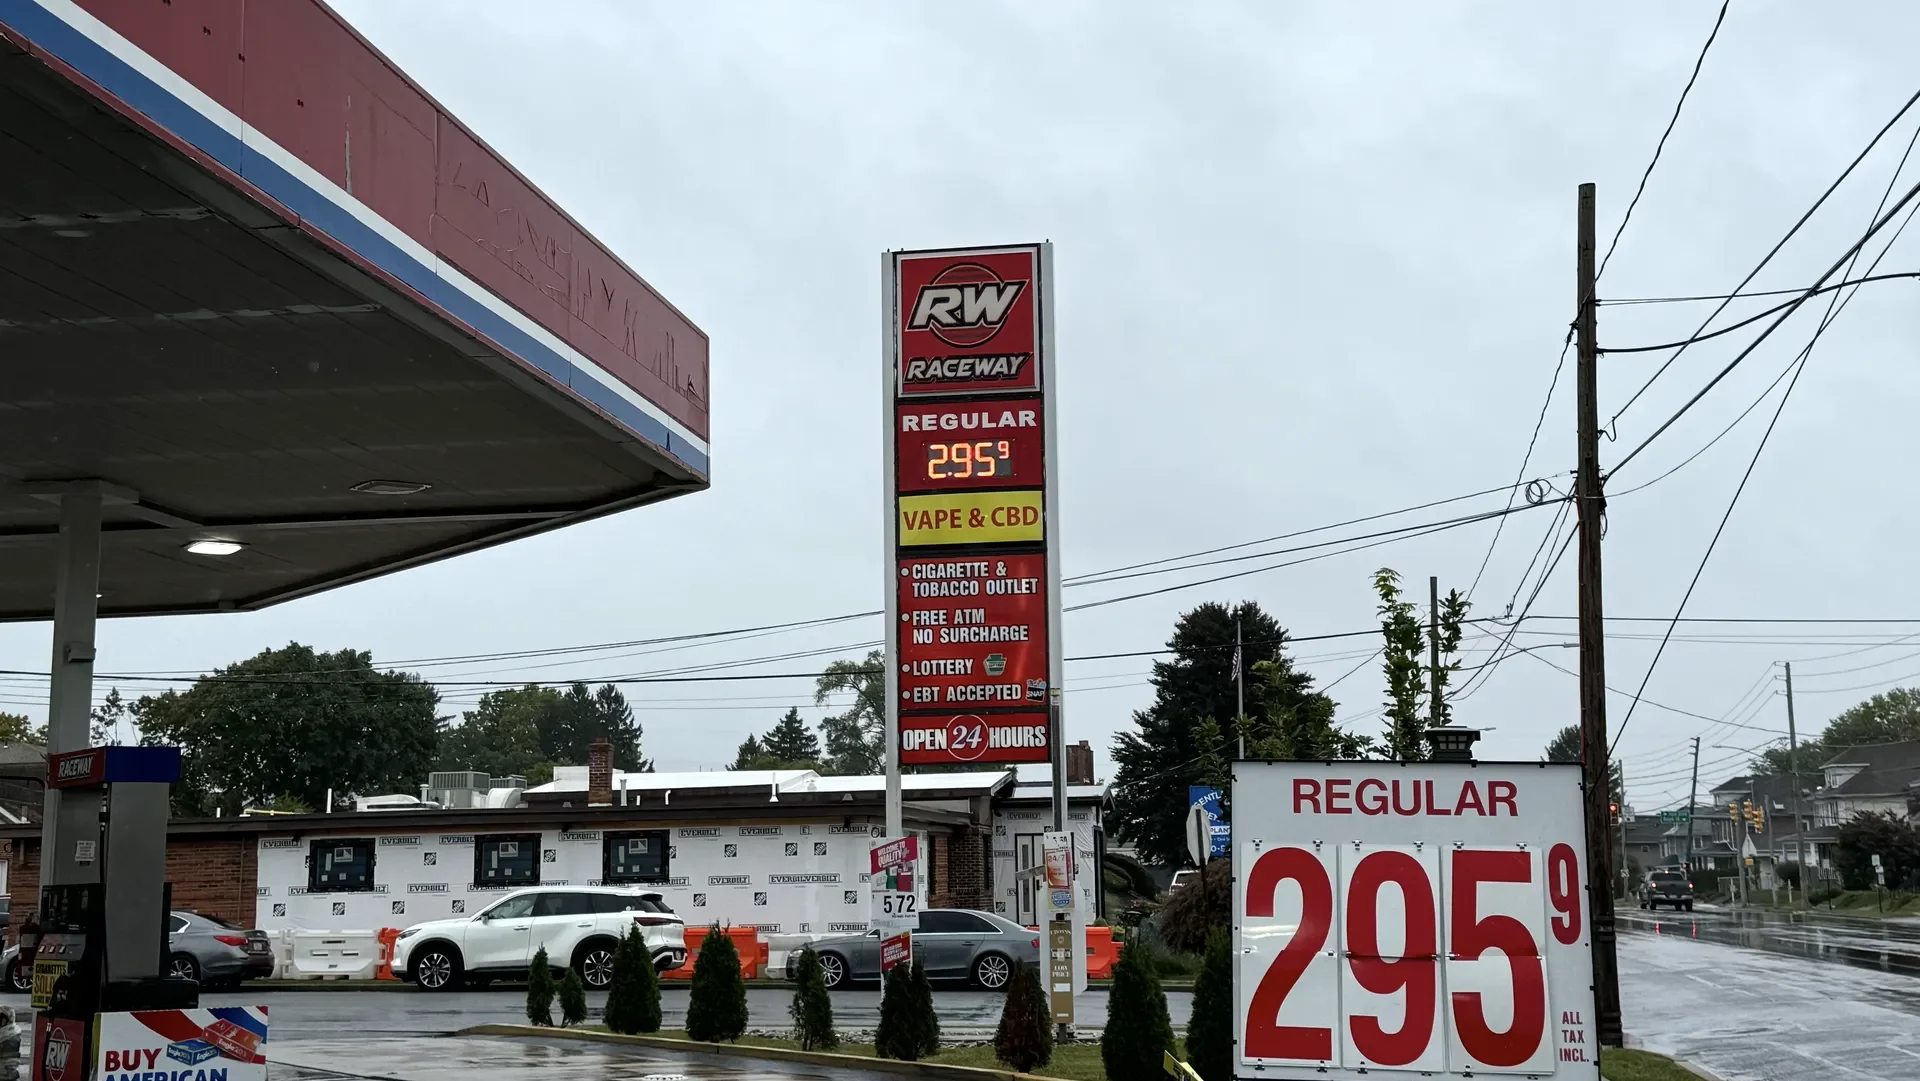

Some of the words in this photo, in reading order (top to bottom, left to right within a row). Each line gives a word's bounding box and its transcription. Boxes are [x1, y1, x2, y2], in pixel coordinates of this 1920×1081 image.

[907, 280, 1026, 330] RW
[906, 353, 1029, 382] RACEWAY
[902, 410, 1037, 432] REGULAR
[903, 508, 962, 531] VAPE
[968, 507, 986, 529] &
[991, 505, 1039, 527] CBD
[912, 561, 989, 579] CIGARETTE
[996, 560, 1007, 577] &
[912, 580, 979, 598] TOBACCO
[986, 578, 1038, 595] OUTLET
[912, 609, 947, 626] FREE
[954, 608, 985, 625] ATM
[913, 628, 932, 645] NO
[940, 625, 1029, 643] SURCHARGE
[913, 658, 973, 676] LOTTERY
[913, 686, 940, 703] EBT
[946, 684, 1022, 702] ACCEPTED
[1026, 690, 1045, 698] SNAP
[903, 729, 947, 751] OPEN
[951, 724, 983, 749] 24
[989, 726, 1047, 749] HOURS
[58, 757, 93, 778] RACEWAY
[1292, 778, 1519, 817] REGULAR
[681, 829, 717, 837] EVERBILT
[742, 827, 779, 835] EVERBILT
[382, 838, 418, 846] EVERBILT
[1562, 1011, 1583, 1025] ALL
[1562, 1029, 1585, 1044] TAX
[46, 1040, 69, 1069] RW
[105, 1048, 162, 1072] BUY
[1559, 1047, 1590, 1063] INCL.
